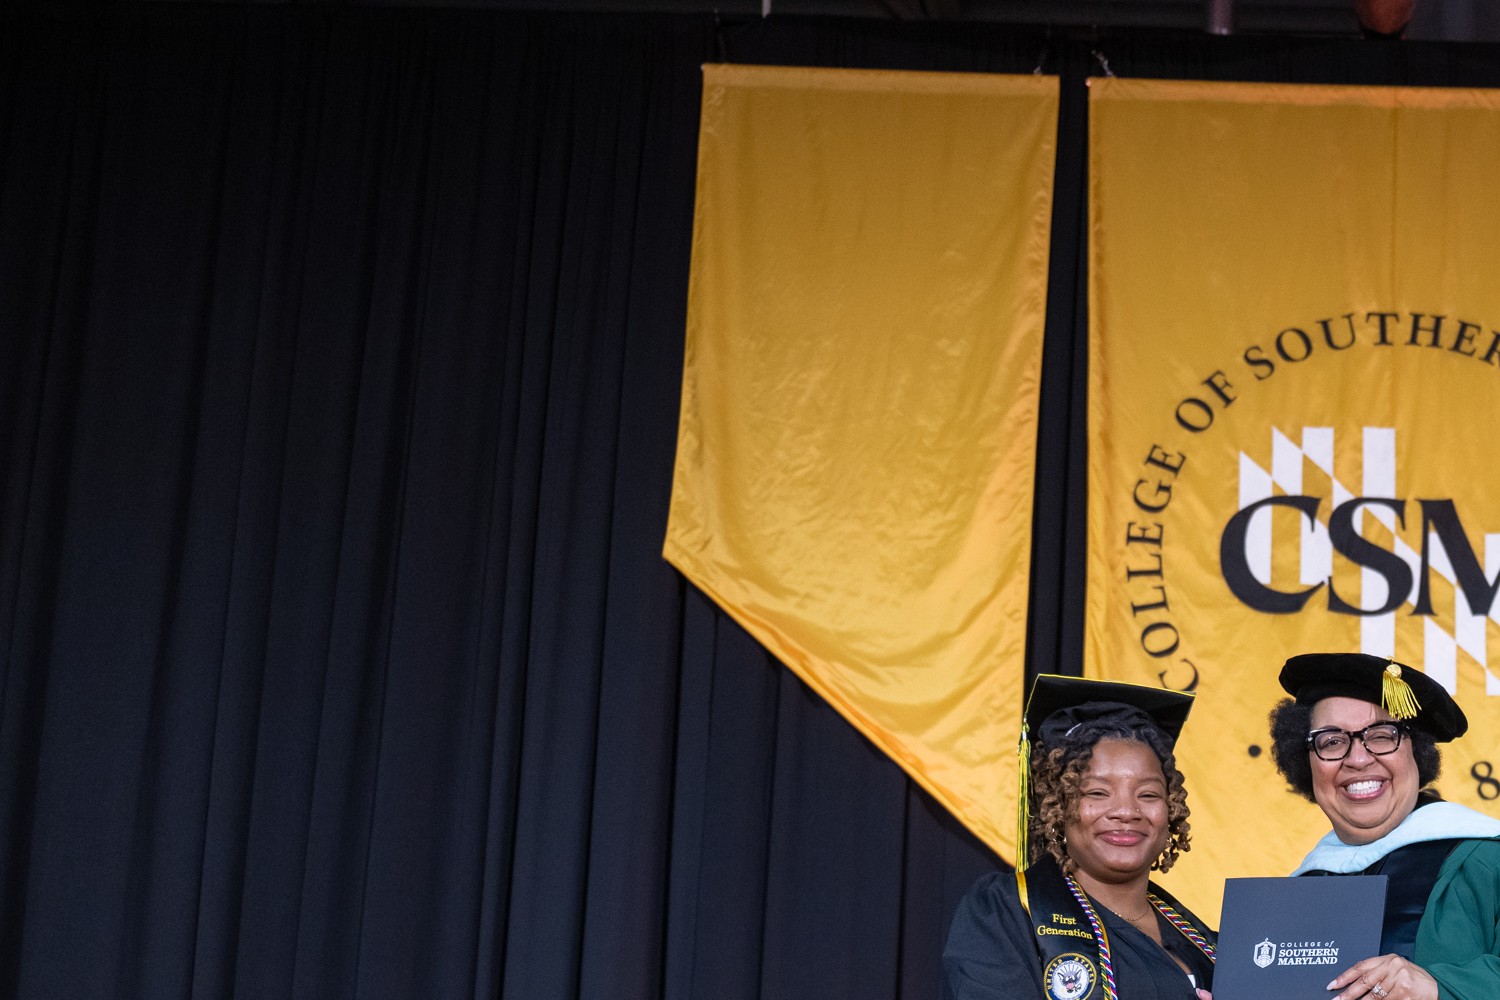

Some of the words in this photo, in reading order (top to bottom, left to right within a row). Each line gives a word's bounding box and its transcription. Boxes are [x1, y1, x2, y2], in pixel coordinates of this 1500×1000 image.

[1126, 444, 1200, 692] COLLEGE
[1174, 370, 1237, 434] OF
[1052, 913, 1077, 925] First
[1037, 925, 1094, 940] Generation
[1324, 940, 1335, 948] of
[1278, 948, 1339, 957] SOUTHERN
[1277, 957, 1338, 965] MARYLAND
[1046, 958, 1063, 990] UNITED
[1074, 956, 1095, 983] STATES
